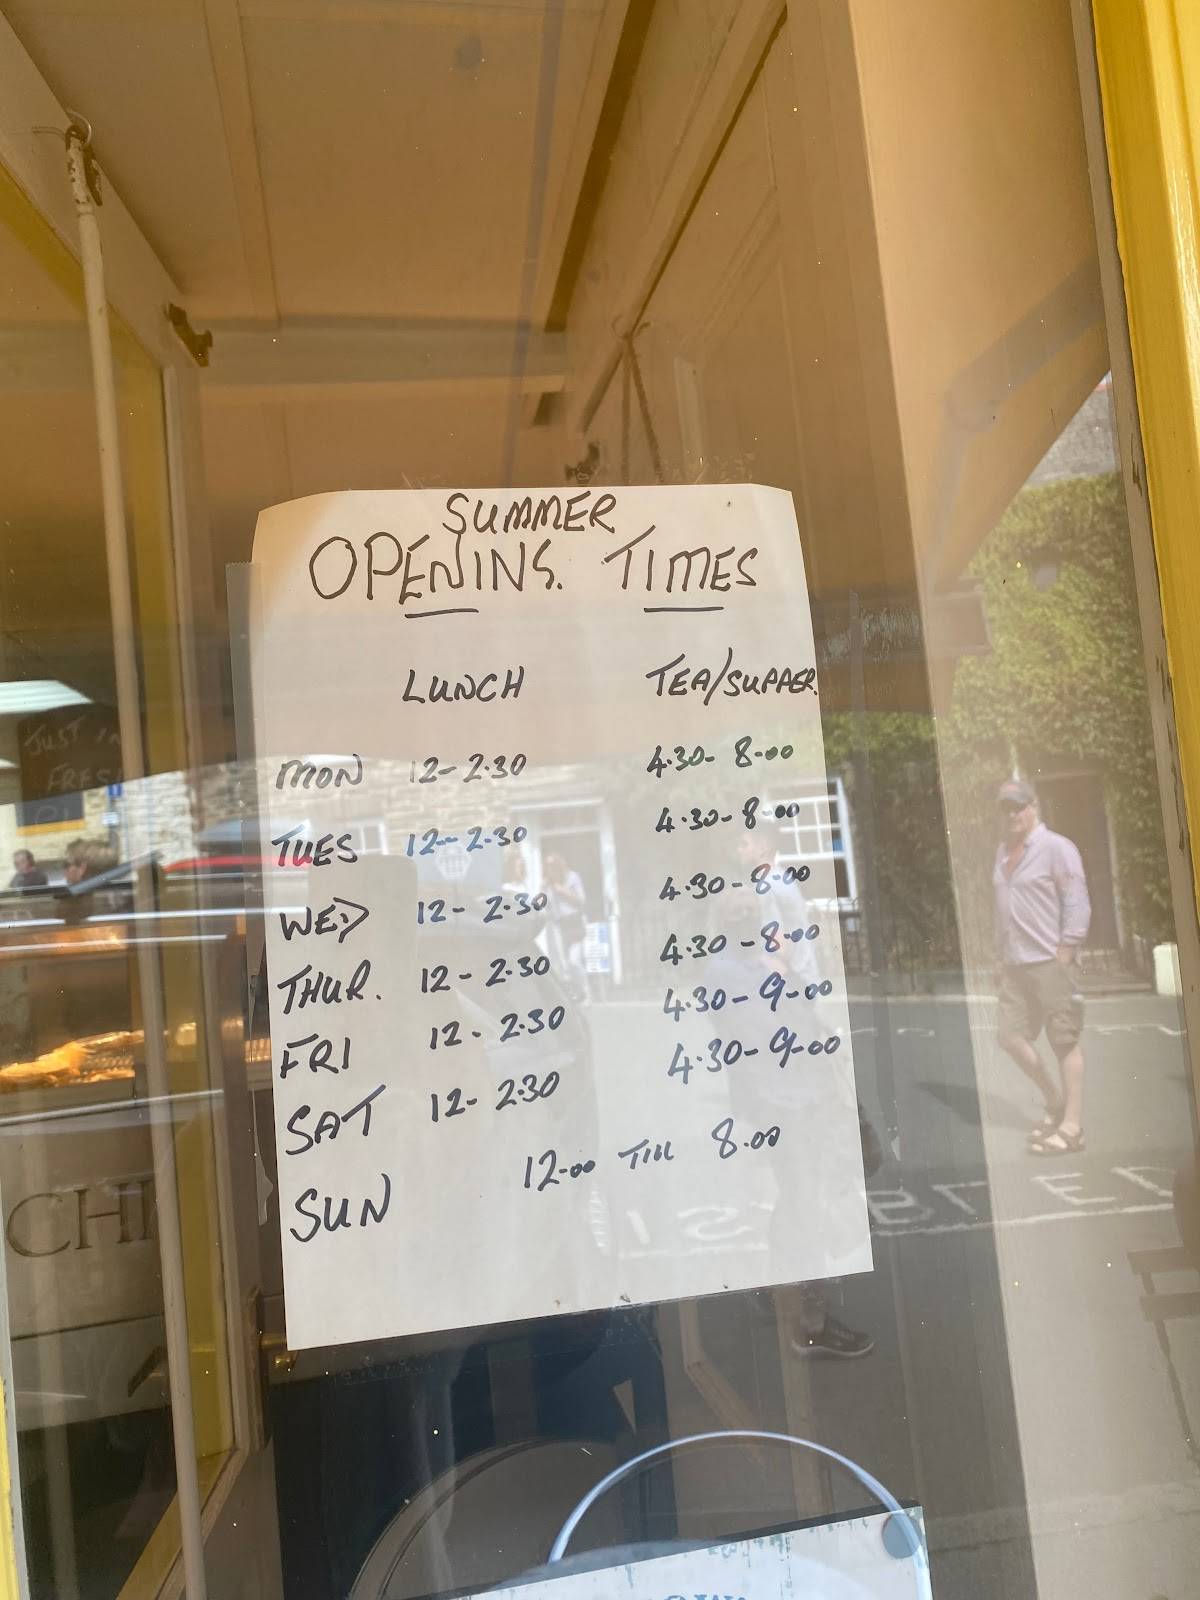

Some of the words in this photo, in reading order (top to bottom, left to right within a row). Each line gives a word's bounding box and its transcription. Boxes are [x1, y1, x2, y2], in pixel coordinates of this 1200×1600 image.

[442, 490, 617, 535] SUMMER
[601, 524, 759, 593] TIMES
[401, 665, 525, 704] LUNCH
[275, 753, 363, 789] MON
[271, 823, 359, 867] TUES
[279, 1033, 351, 1079] FRI
[285, 1084, 387, 1156] SAT
[289, 1173, 392, 1243] SUN
